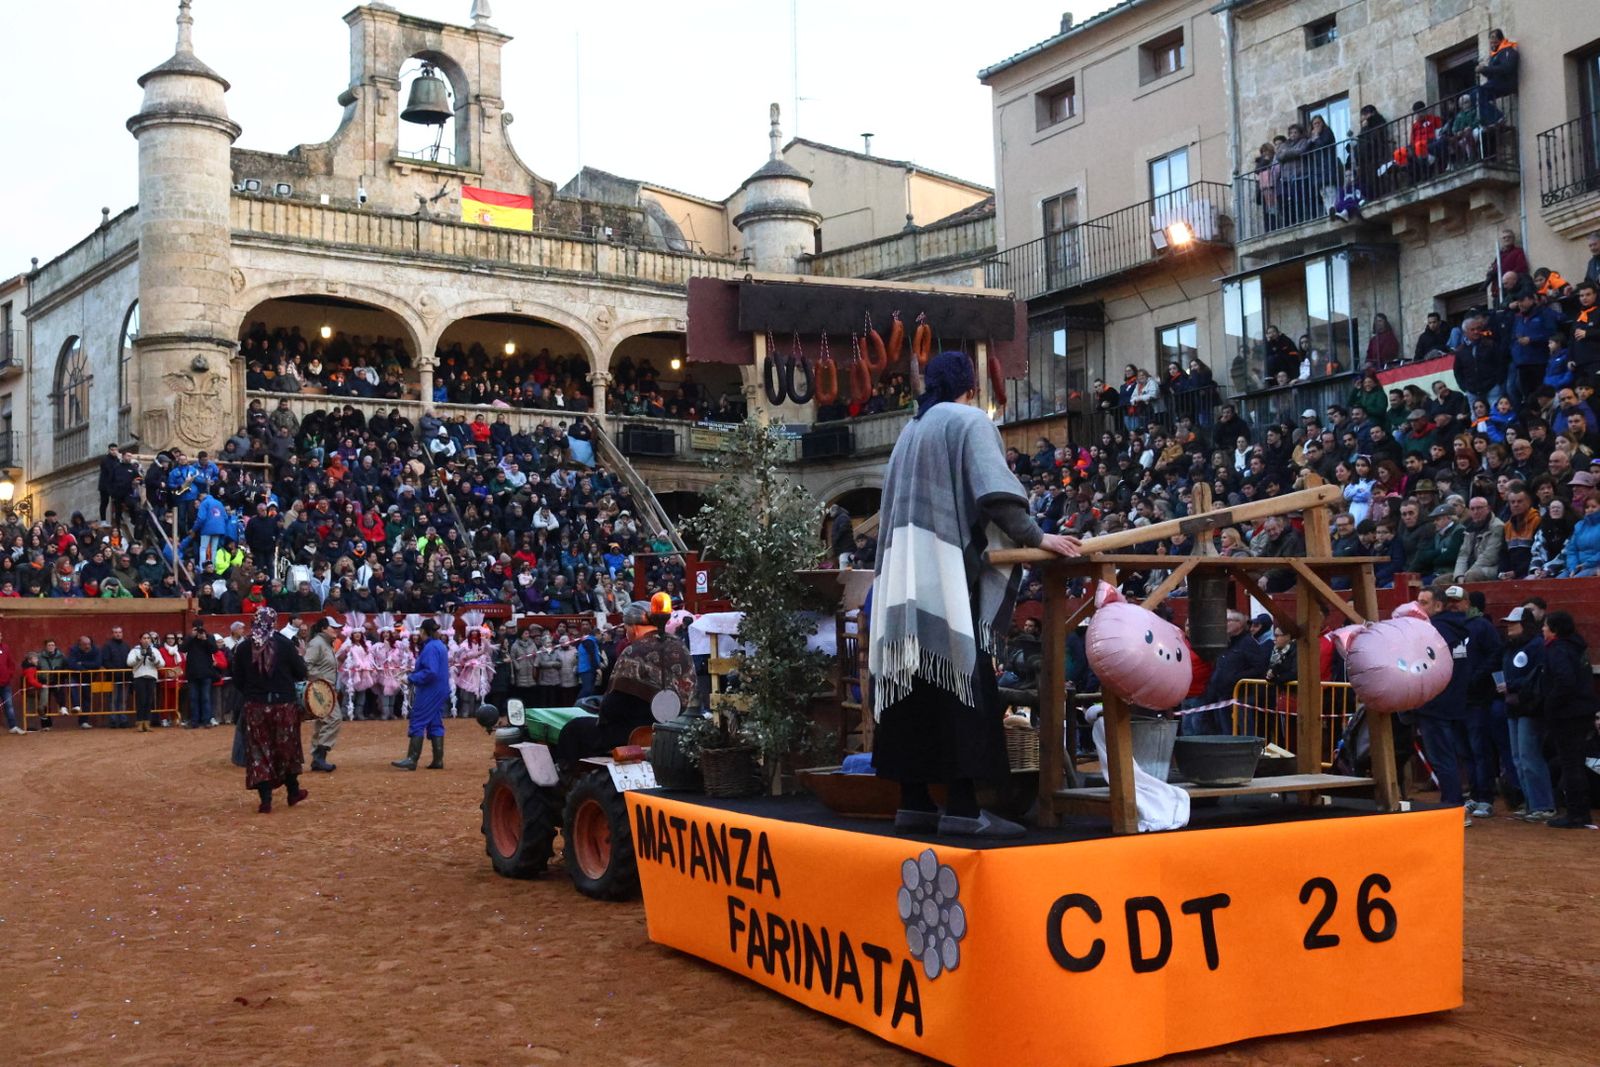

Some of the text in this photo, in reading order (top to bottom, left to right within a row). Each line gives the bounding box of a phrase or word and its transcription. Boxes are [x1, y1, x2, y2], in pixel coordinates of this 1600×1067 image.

[635, 803, 781, 898] MATANZA
[727, 894, 923, 1037] FARINATA
[1046, 873, 1398, 973] CDT 26
